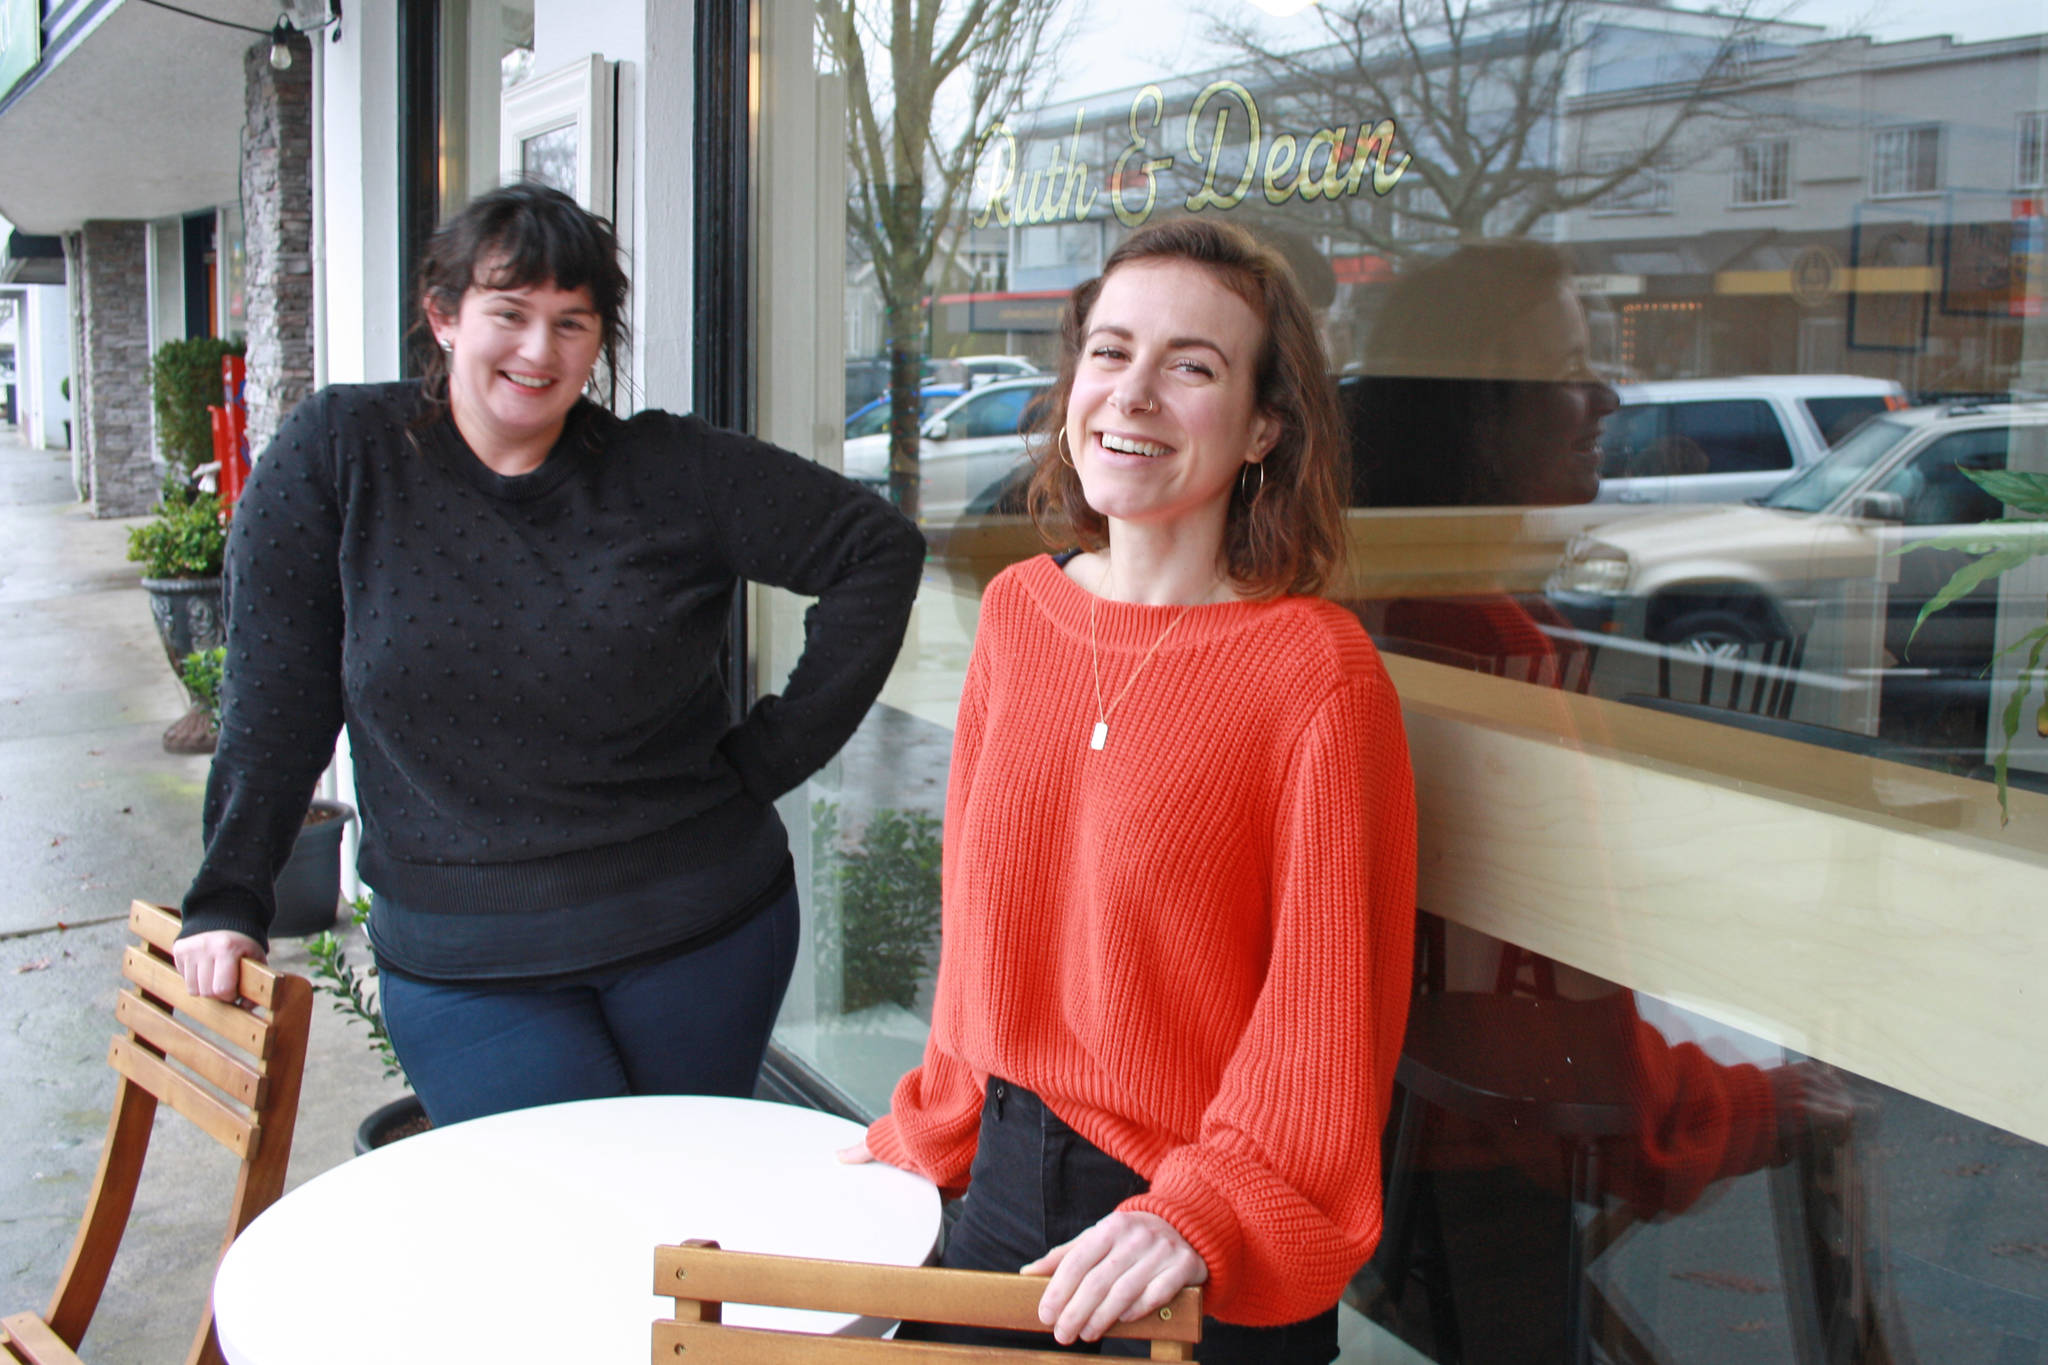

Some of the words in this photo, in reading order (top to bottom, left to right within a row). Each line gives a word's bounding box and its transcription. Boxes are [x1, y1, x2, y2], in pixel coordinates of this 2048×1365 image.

[973, 105, 1098, 229] Ruth
[1111, 84, 1174, 228] &
[1184, 79, 1413, 212] Dean
